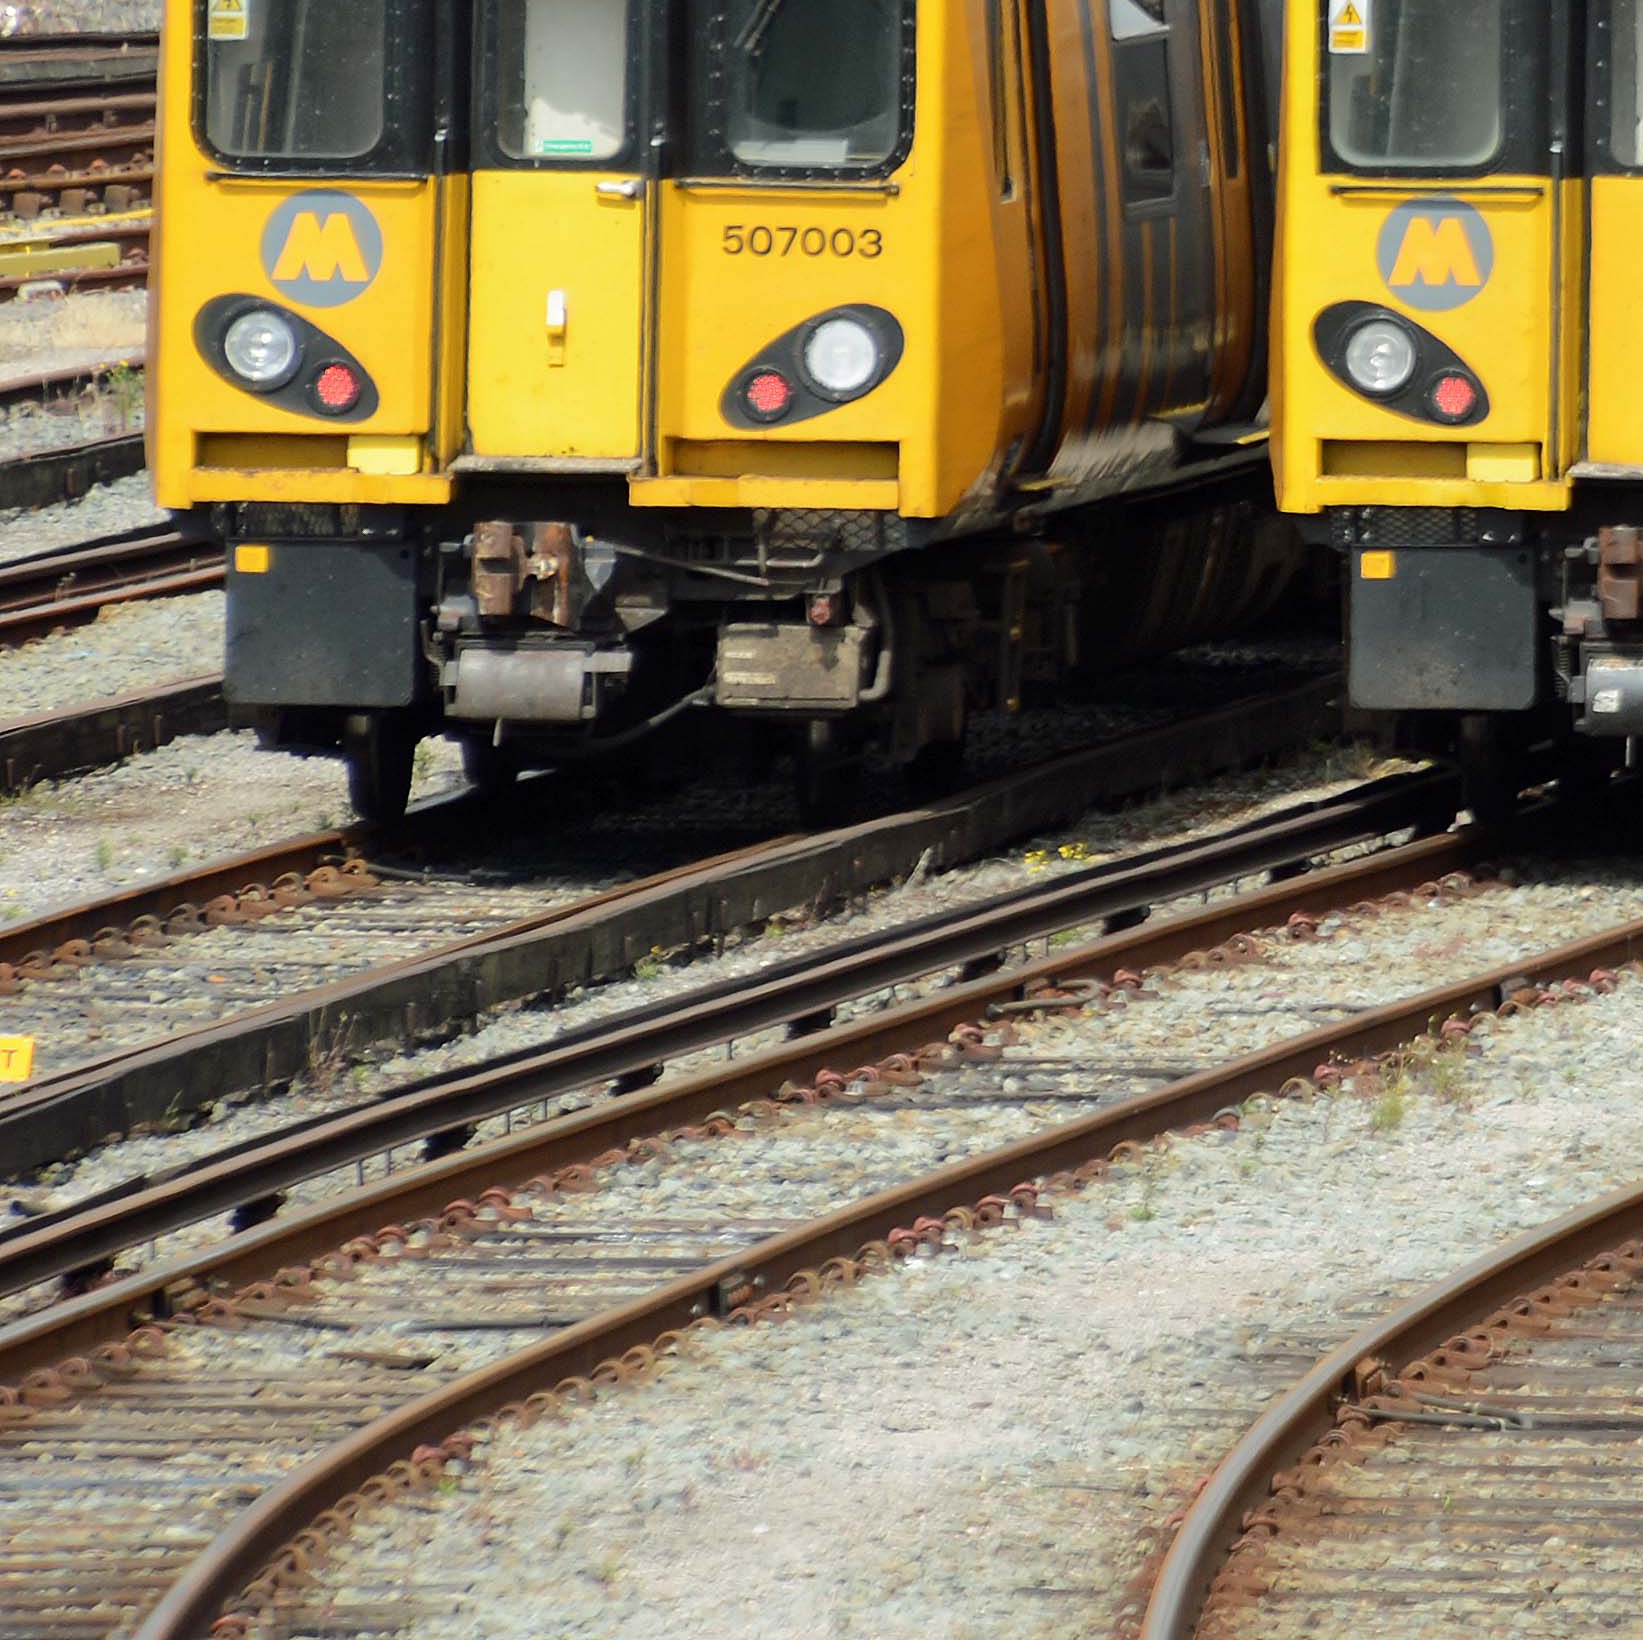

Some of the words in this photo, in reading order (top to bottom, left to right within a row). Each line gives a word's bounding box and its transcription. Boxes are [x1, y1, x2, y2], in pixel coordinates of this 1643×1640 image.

[271, 210, 370, 282] M
[722, 224, 883, 259] 507003
[1388, 216, 1482, 287] M
